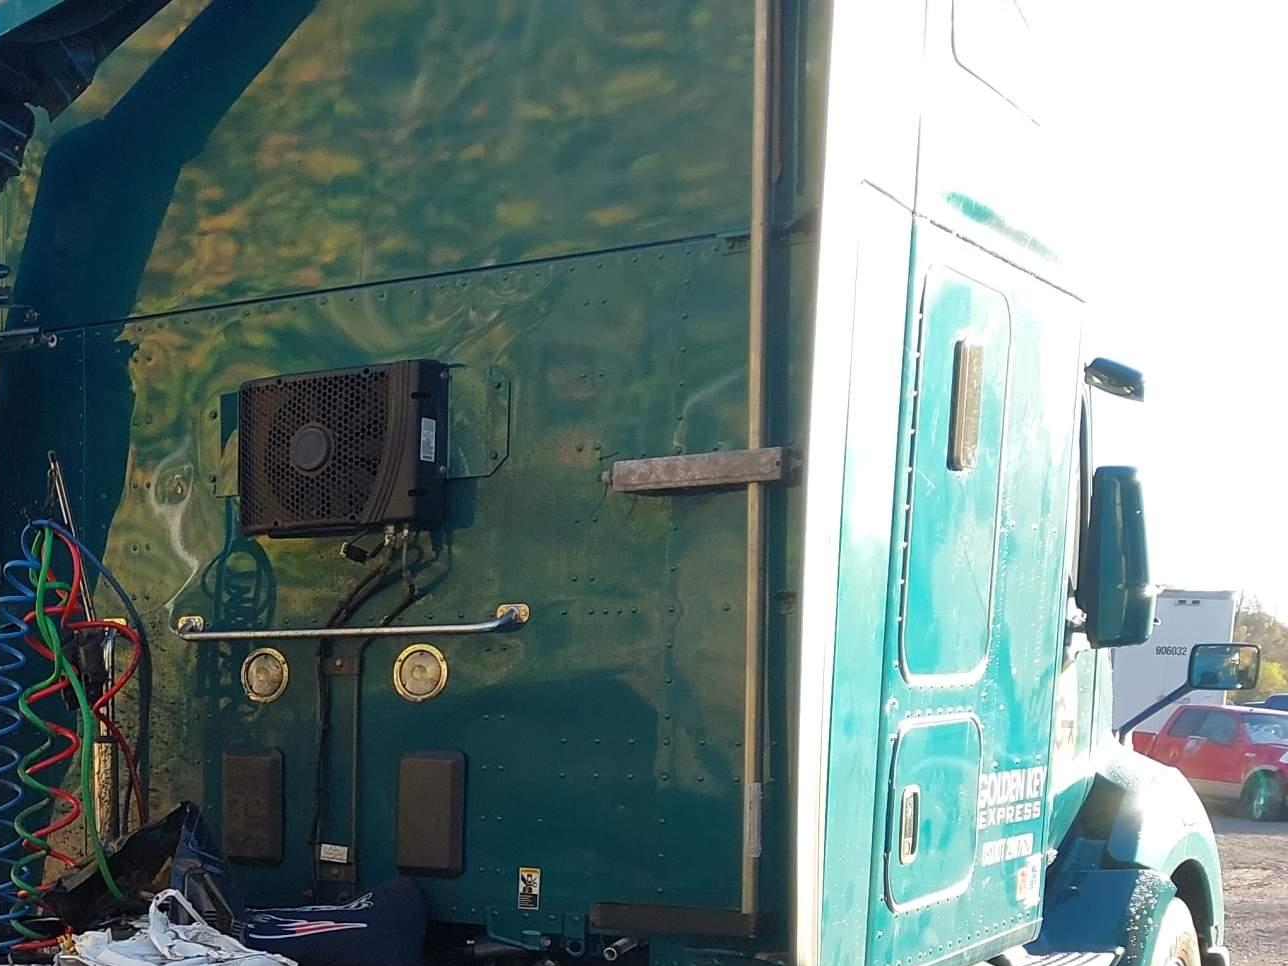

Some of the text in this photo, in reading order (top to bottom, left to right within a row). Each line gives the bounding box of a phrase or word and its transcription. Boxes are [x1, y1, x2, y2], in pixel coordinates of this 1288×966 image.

[1155, 646, 1188, 656] 906032
[979, 769, 1025, 808] GOLDEN
[979, 801, 1040, 830] EXPRESS
